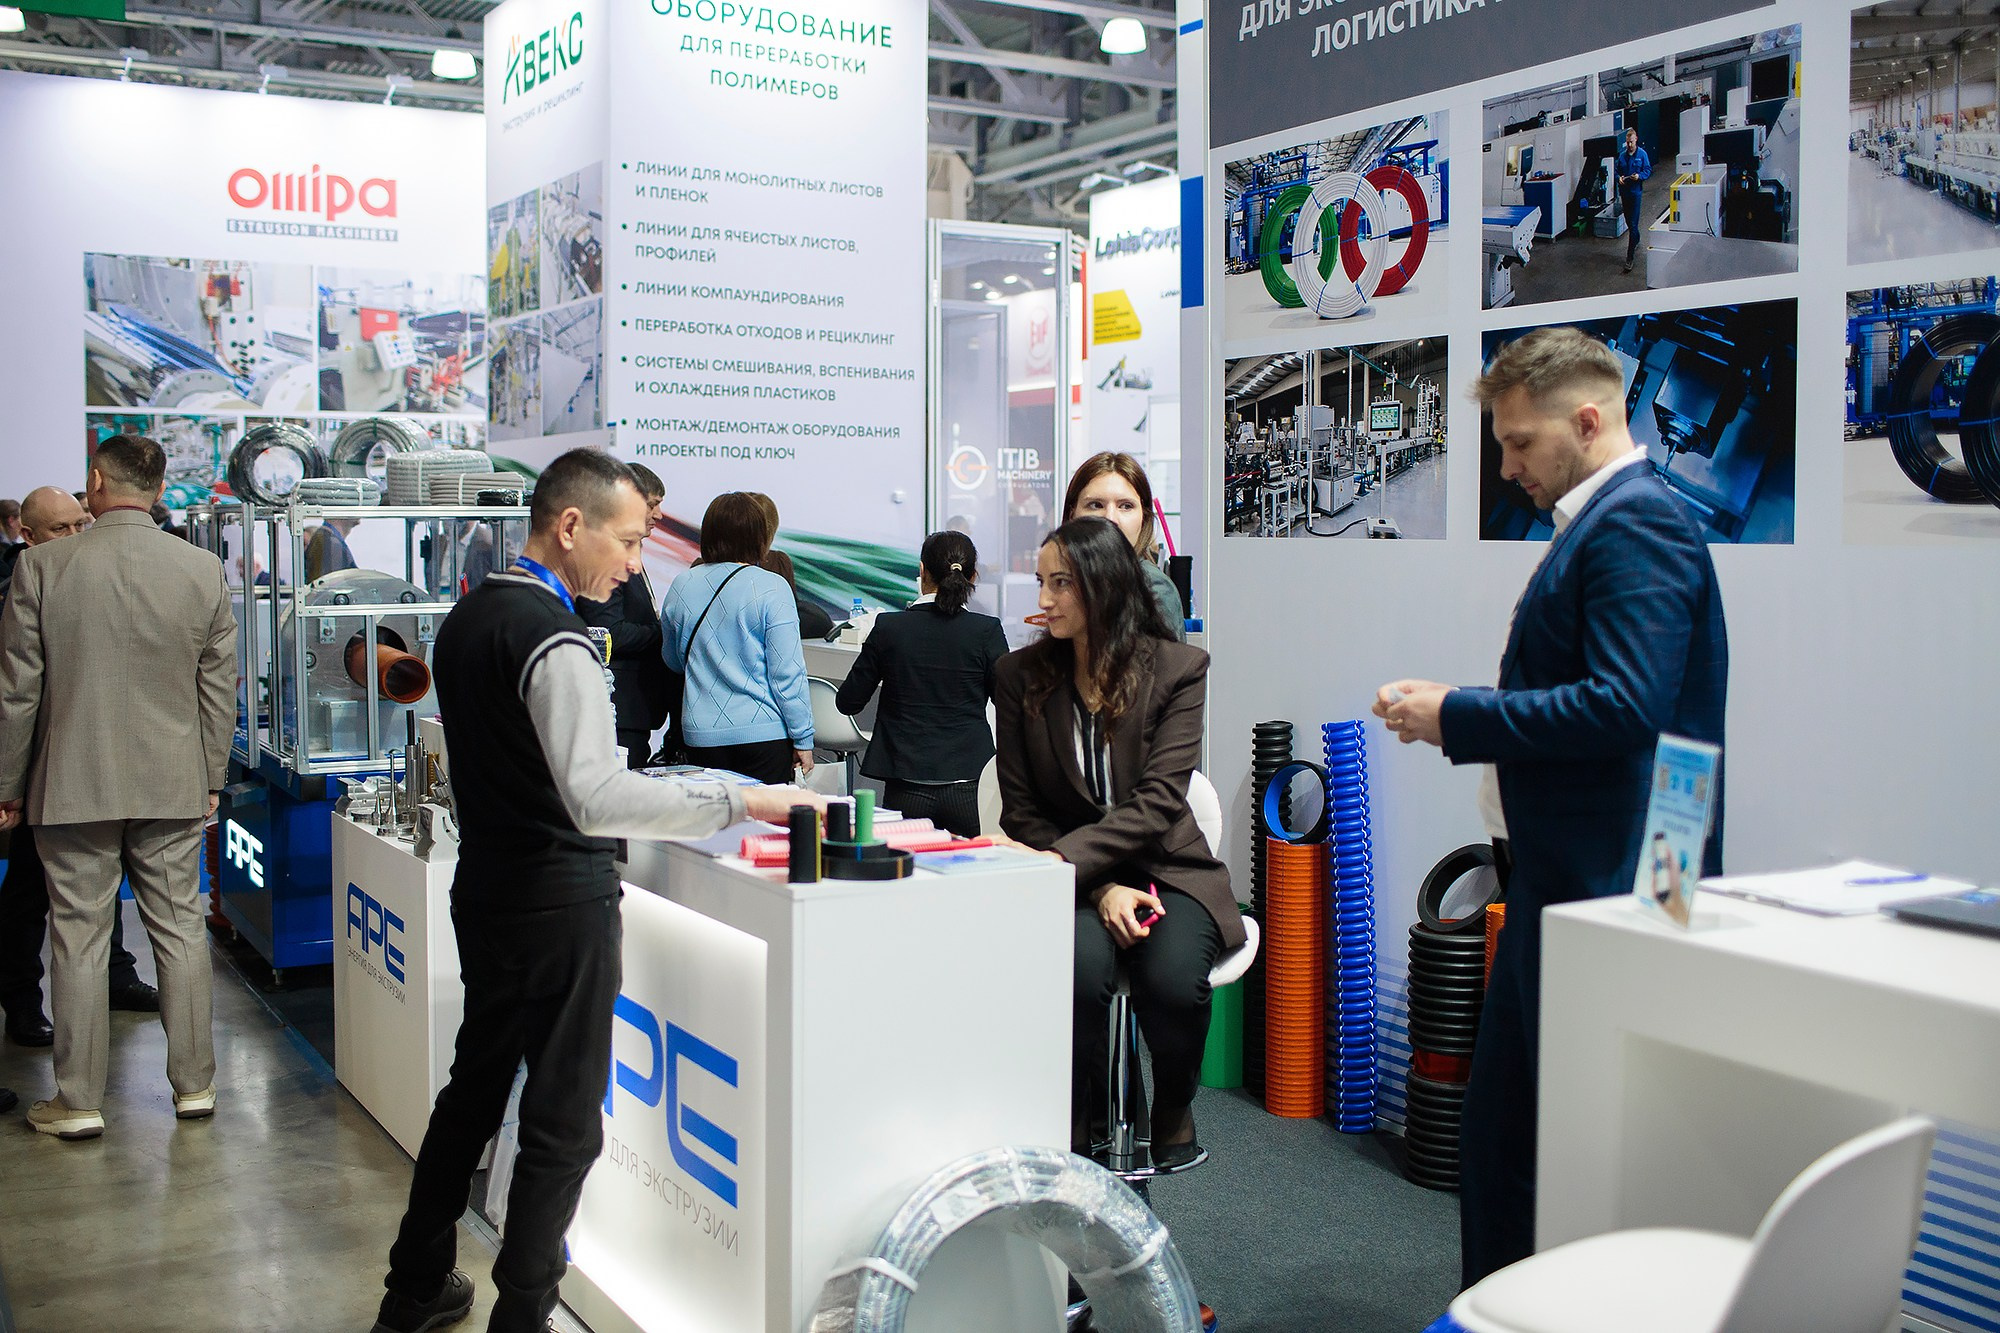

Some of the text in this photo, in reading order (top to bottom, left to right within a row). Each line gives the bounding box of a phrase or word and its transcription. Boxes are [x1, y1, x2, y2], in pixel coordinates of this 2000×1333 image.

[651, 0, 892, 48] ОБОРУДОВАНИЕ
[1239, 0, 1291, 41] ДЛЯ
[680, 34, 867, 75] ДЛЯ ПЕРЕРАБОТКИ
[710, 69, 839, 100] ПОЛИМЕРОВ
[635, 161, 885, 199] ЛИНИИ ДЛЯ МОНОЛИТНЫХ ЛИСТОВ
[636, 185, 709, 204] И ПЛЕНОК
[228, 219, 397, 241] EXTRUSION MACHINERY
[635, 221, 860, 255] ЛИНИИ ДЛЯ ЯЧЕИСТЫХ ЛИСТОВ,
[635, 244, 717, 263] ПРОФИЛЕЙ
[635, 281, 845, 308] ЛИНИИ КОМПАУНДИРОВАНИЯ
[635, 318, 895, 346] ПЕРЕРАБОТКА ОТХОДОВ И РЕЦИКЛИНГ
[635, 355, 916, 382] СИСТЕМЫ СМЕШИВАНИЯ, ВСПЕНИВАНИЯ
[635, 381, 836, 401] И ОХЛАЖДЕНИЯ ПЛАСТИКОВ
[636, 418, 901, 438] МОНТАЖ/ДЕМОНТАЖ ОБОРУДОВАНИЯ
[636, 443, 796, 460] И ПРОЕКТЫ ПОД КЛЮЧ
[997, 448, 1040, 469] ITIB
[997, 470, 1052, 480] MACHINERY
[603, 992, 739, 1210] PE
[609, 1135, 739, 1257] ДЛЯ ЭКСТРУЗИИ
